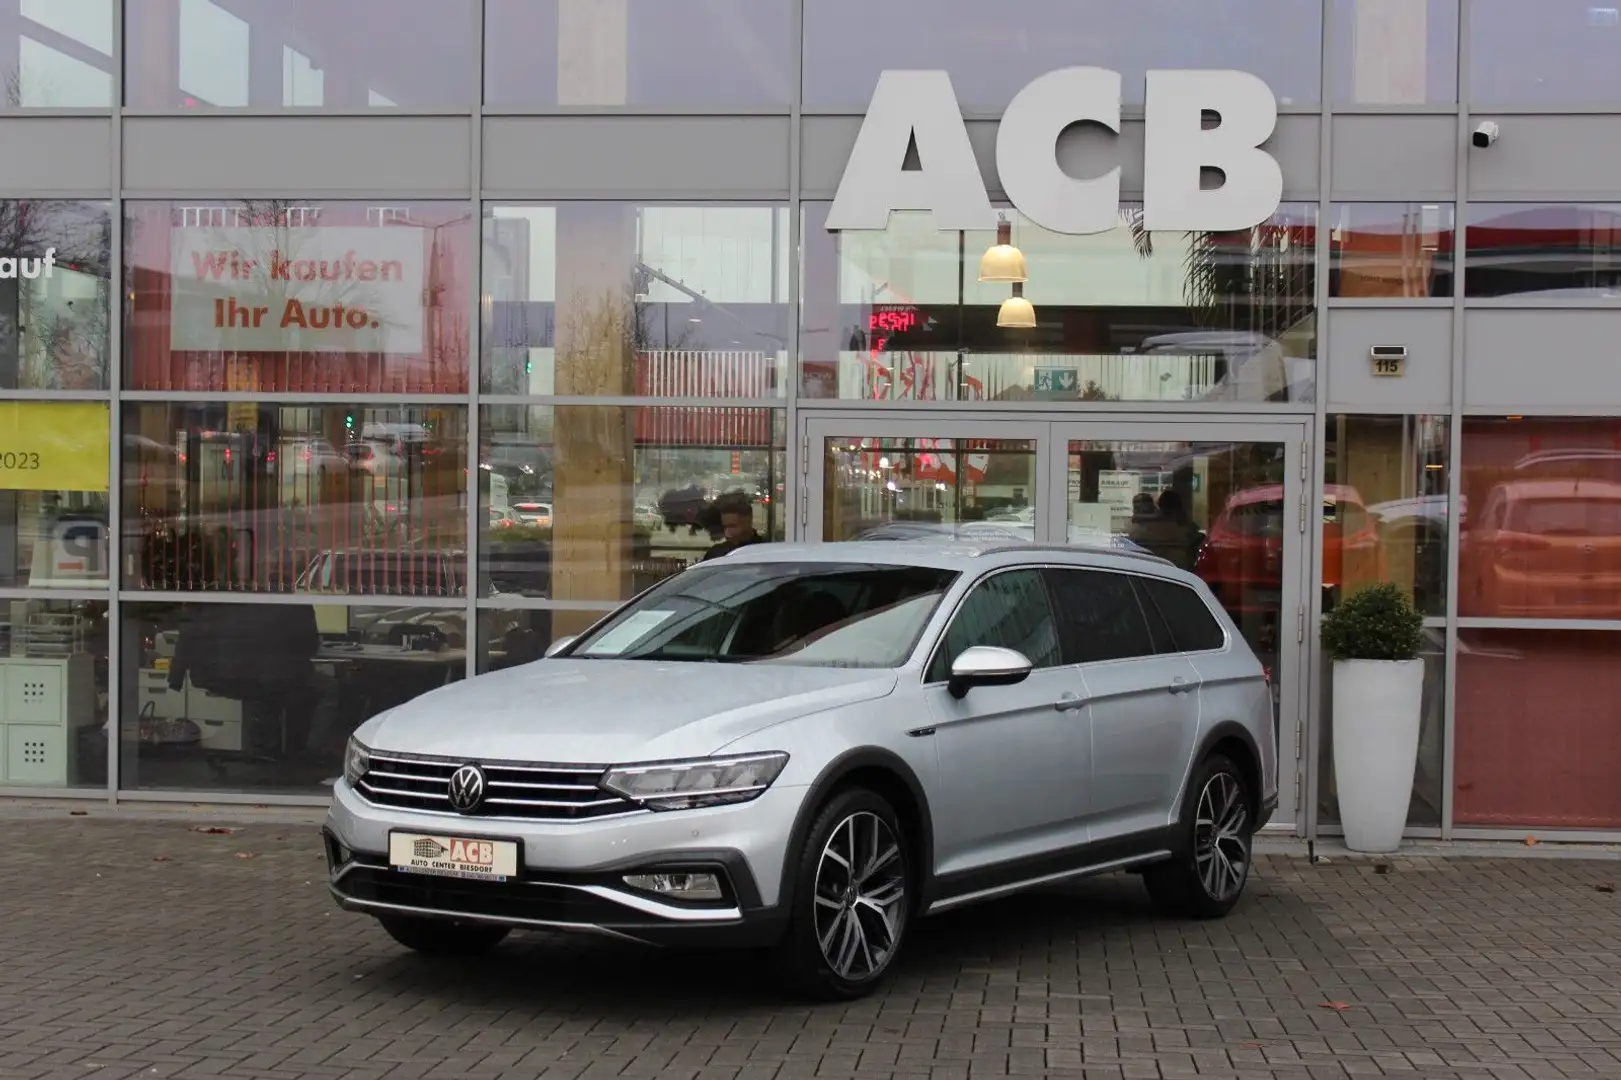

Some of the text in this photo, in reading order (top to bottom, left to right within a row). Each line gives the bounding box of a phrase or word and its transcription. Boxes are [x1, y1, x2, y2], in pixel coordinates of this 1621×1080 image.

[824, 66, 1283, 235] ACB
[0, 247, 56, 279] auf
[191, 249, 403, 282] Wir kaufen
[214, 297, 379, 329] Ihr Auto.
[1375, 360, 1398, 372] 115
[411, 859, 428, 868] AUTO
[432, 861, 456, 870] CENTER
[460, 864, 493, 874] BIESDORF
[450, 838, 493, 865] ACB
